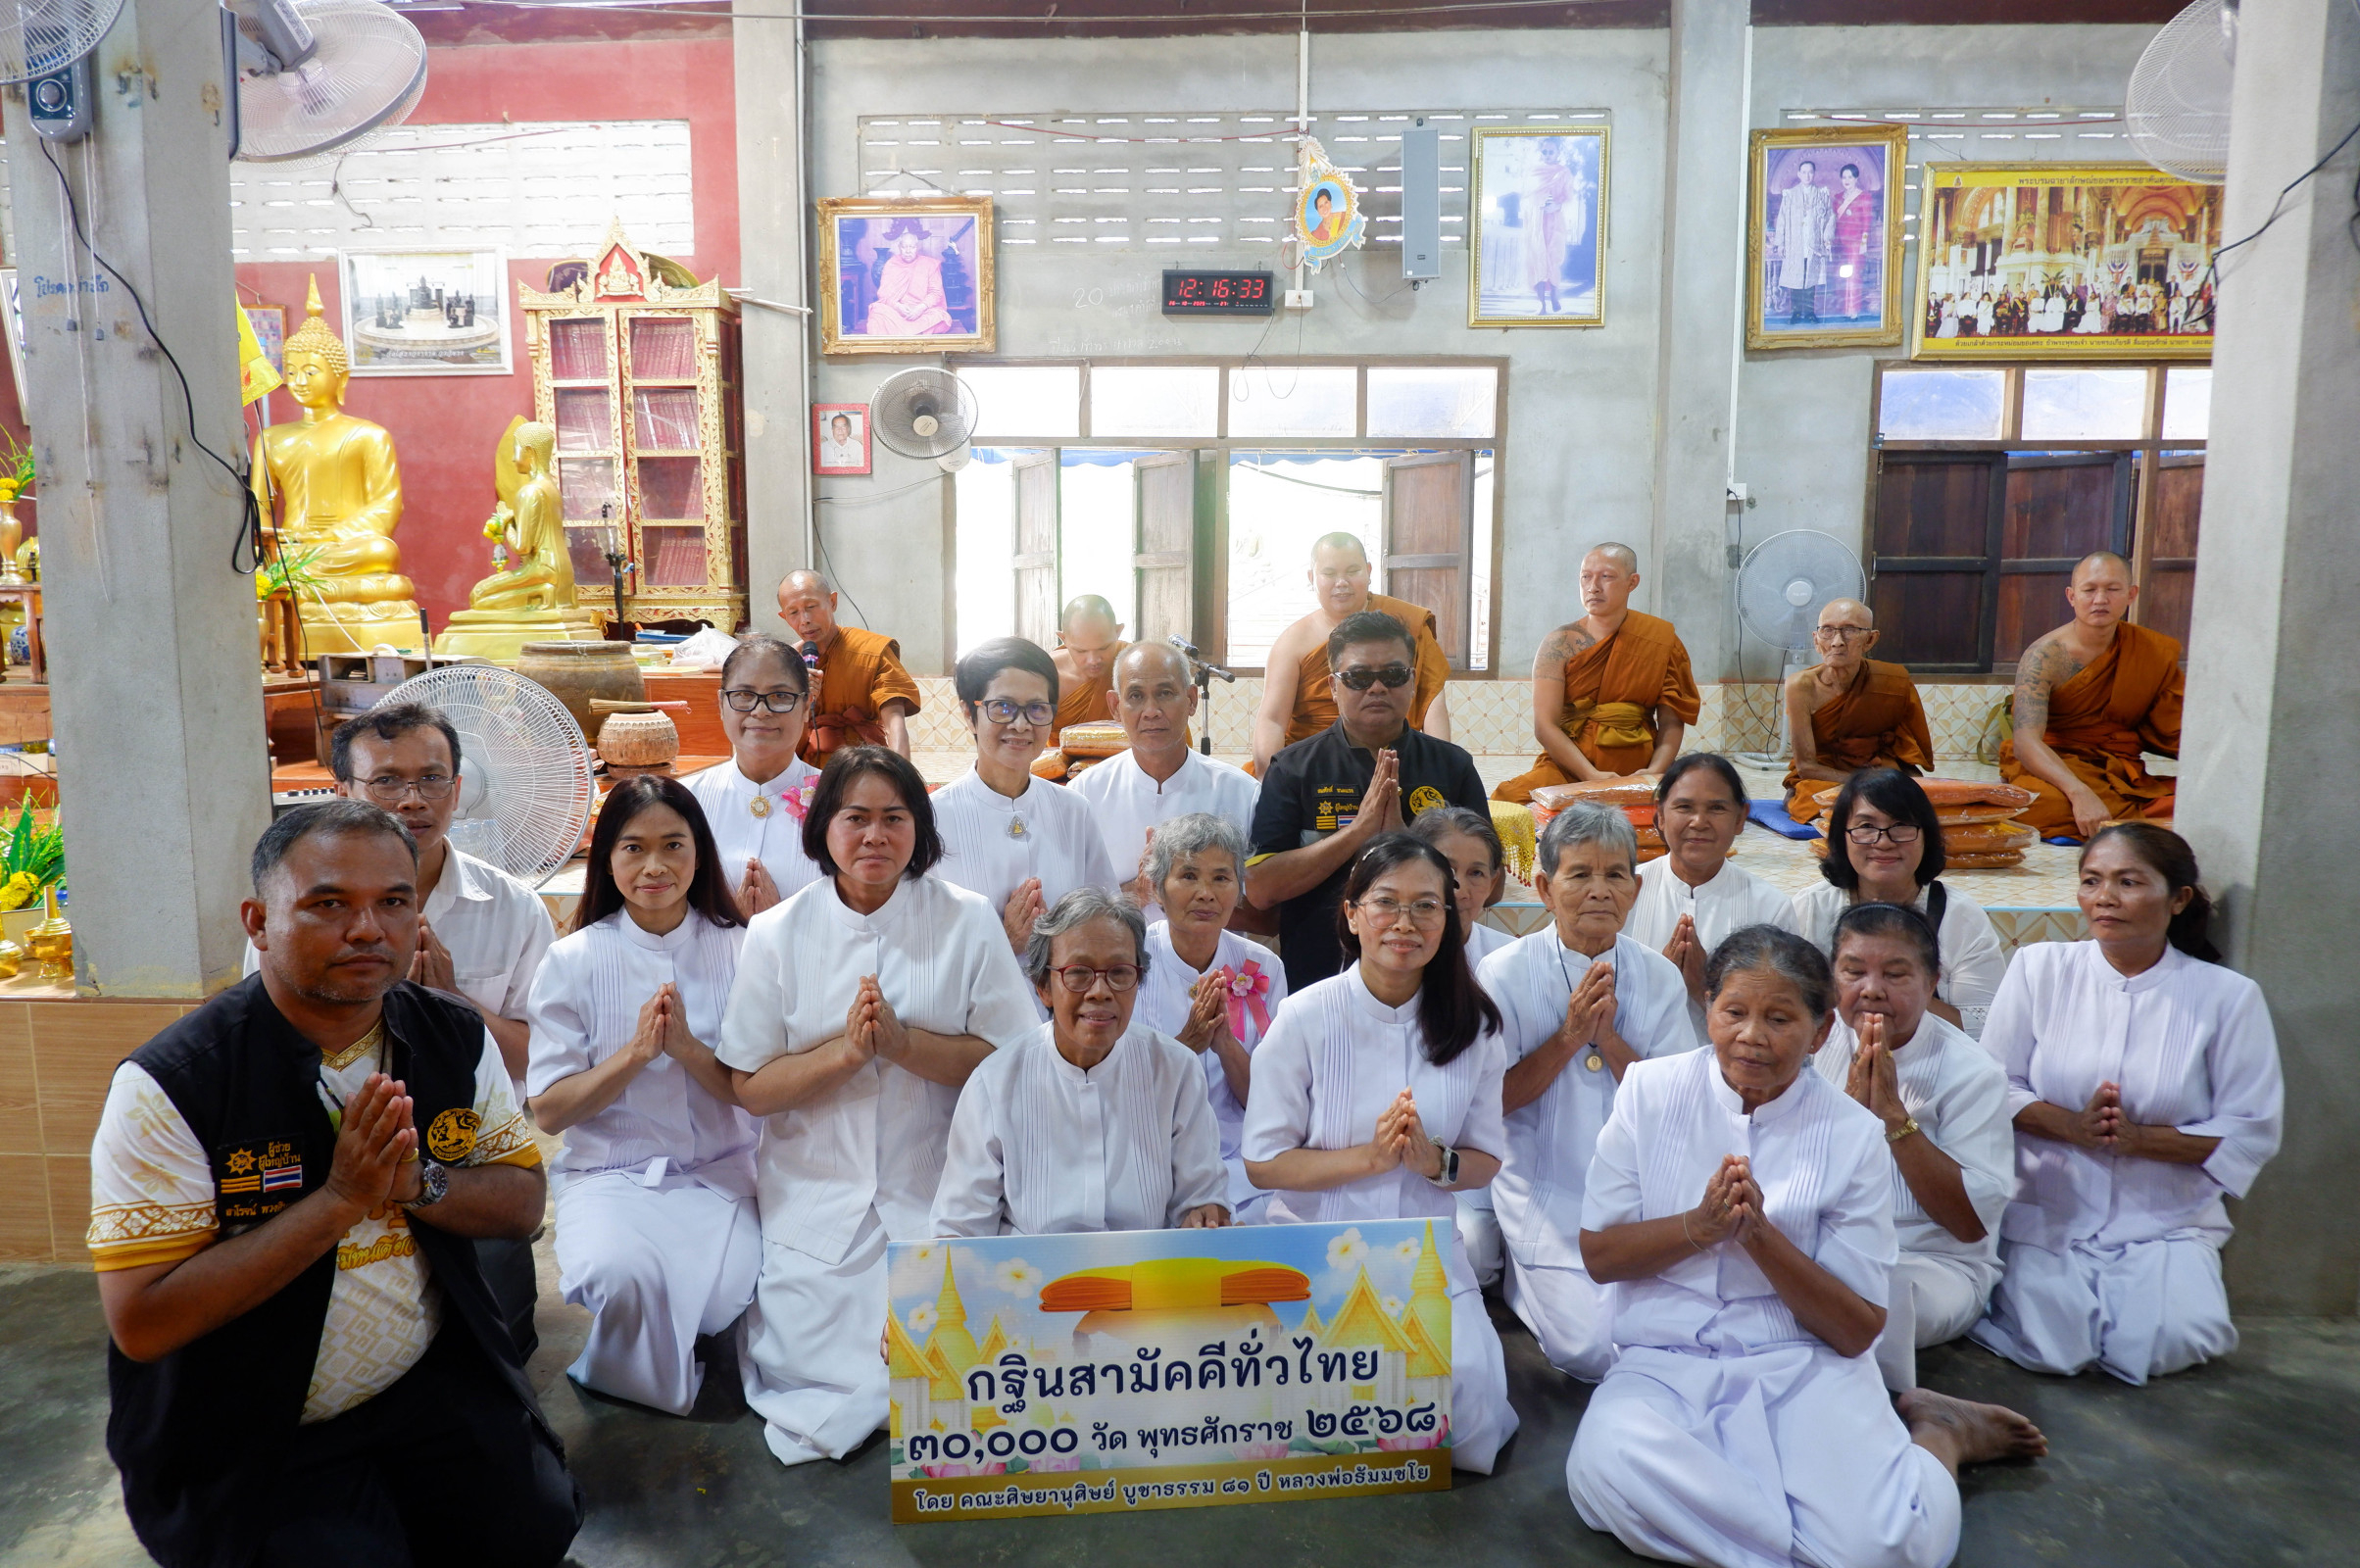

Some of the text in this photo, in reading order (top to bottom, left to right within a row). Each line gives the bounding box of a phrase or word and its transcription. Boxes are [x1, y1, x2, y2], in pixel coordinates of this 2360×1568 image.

[1179, 278, 1264, 299] 12:16:33
[259, 1153, 301, 1172] ผู้ใหญ่บ้าน
[269, 1142, 291, 1157] ผู้ช่วย
[967, 1327, 1378, 1414] กฐินสามัคคีทั่วไทย
[910, 1401, 1437, 1464] ๓๐,๐๐๐ วัด พุทธศักราช ๒๕๖๘
[915, 1491, 953, 1510] โดย
[961, 1480, 1115, 1508] คณะศิษยานุศิษย์
[1122, 1481, 1215, 1505] บูชาธรรม
[1258, 1472, 1271, 1492] ปี
[1279, 1462, 1430, 1489] หลวงพ่อธัมมชโย
